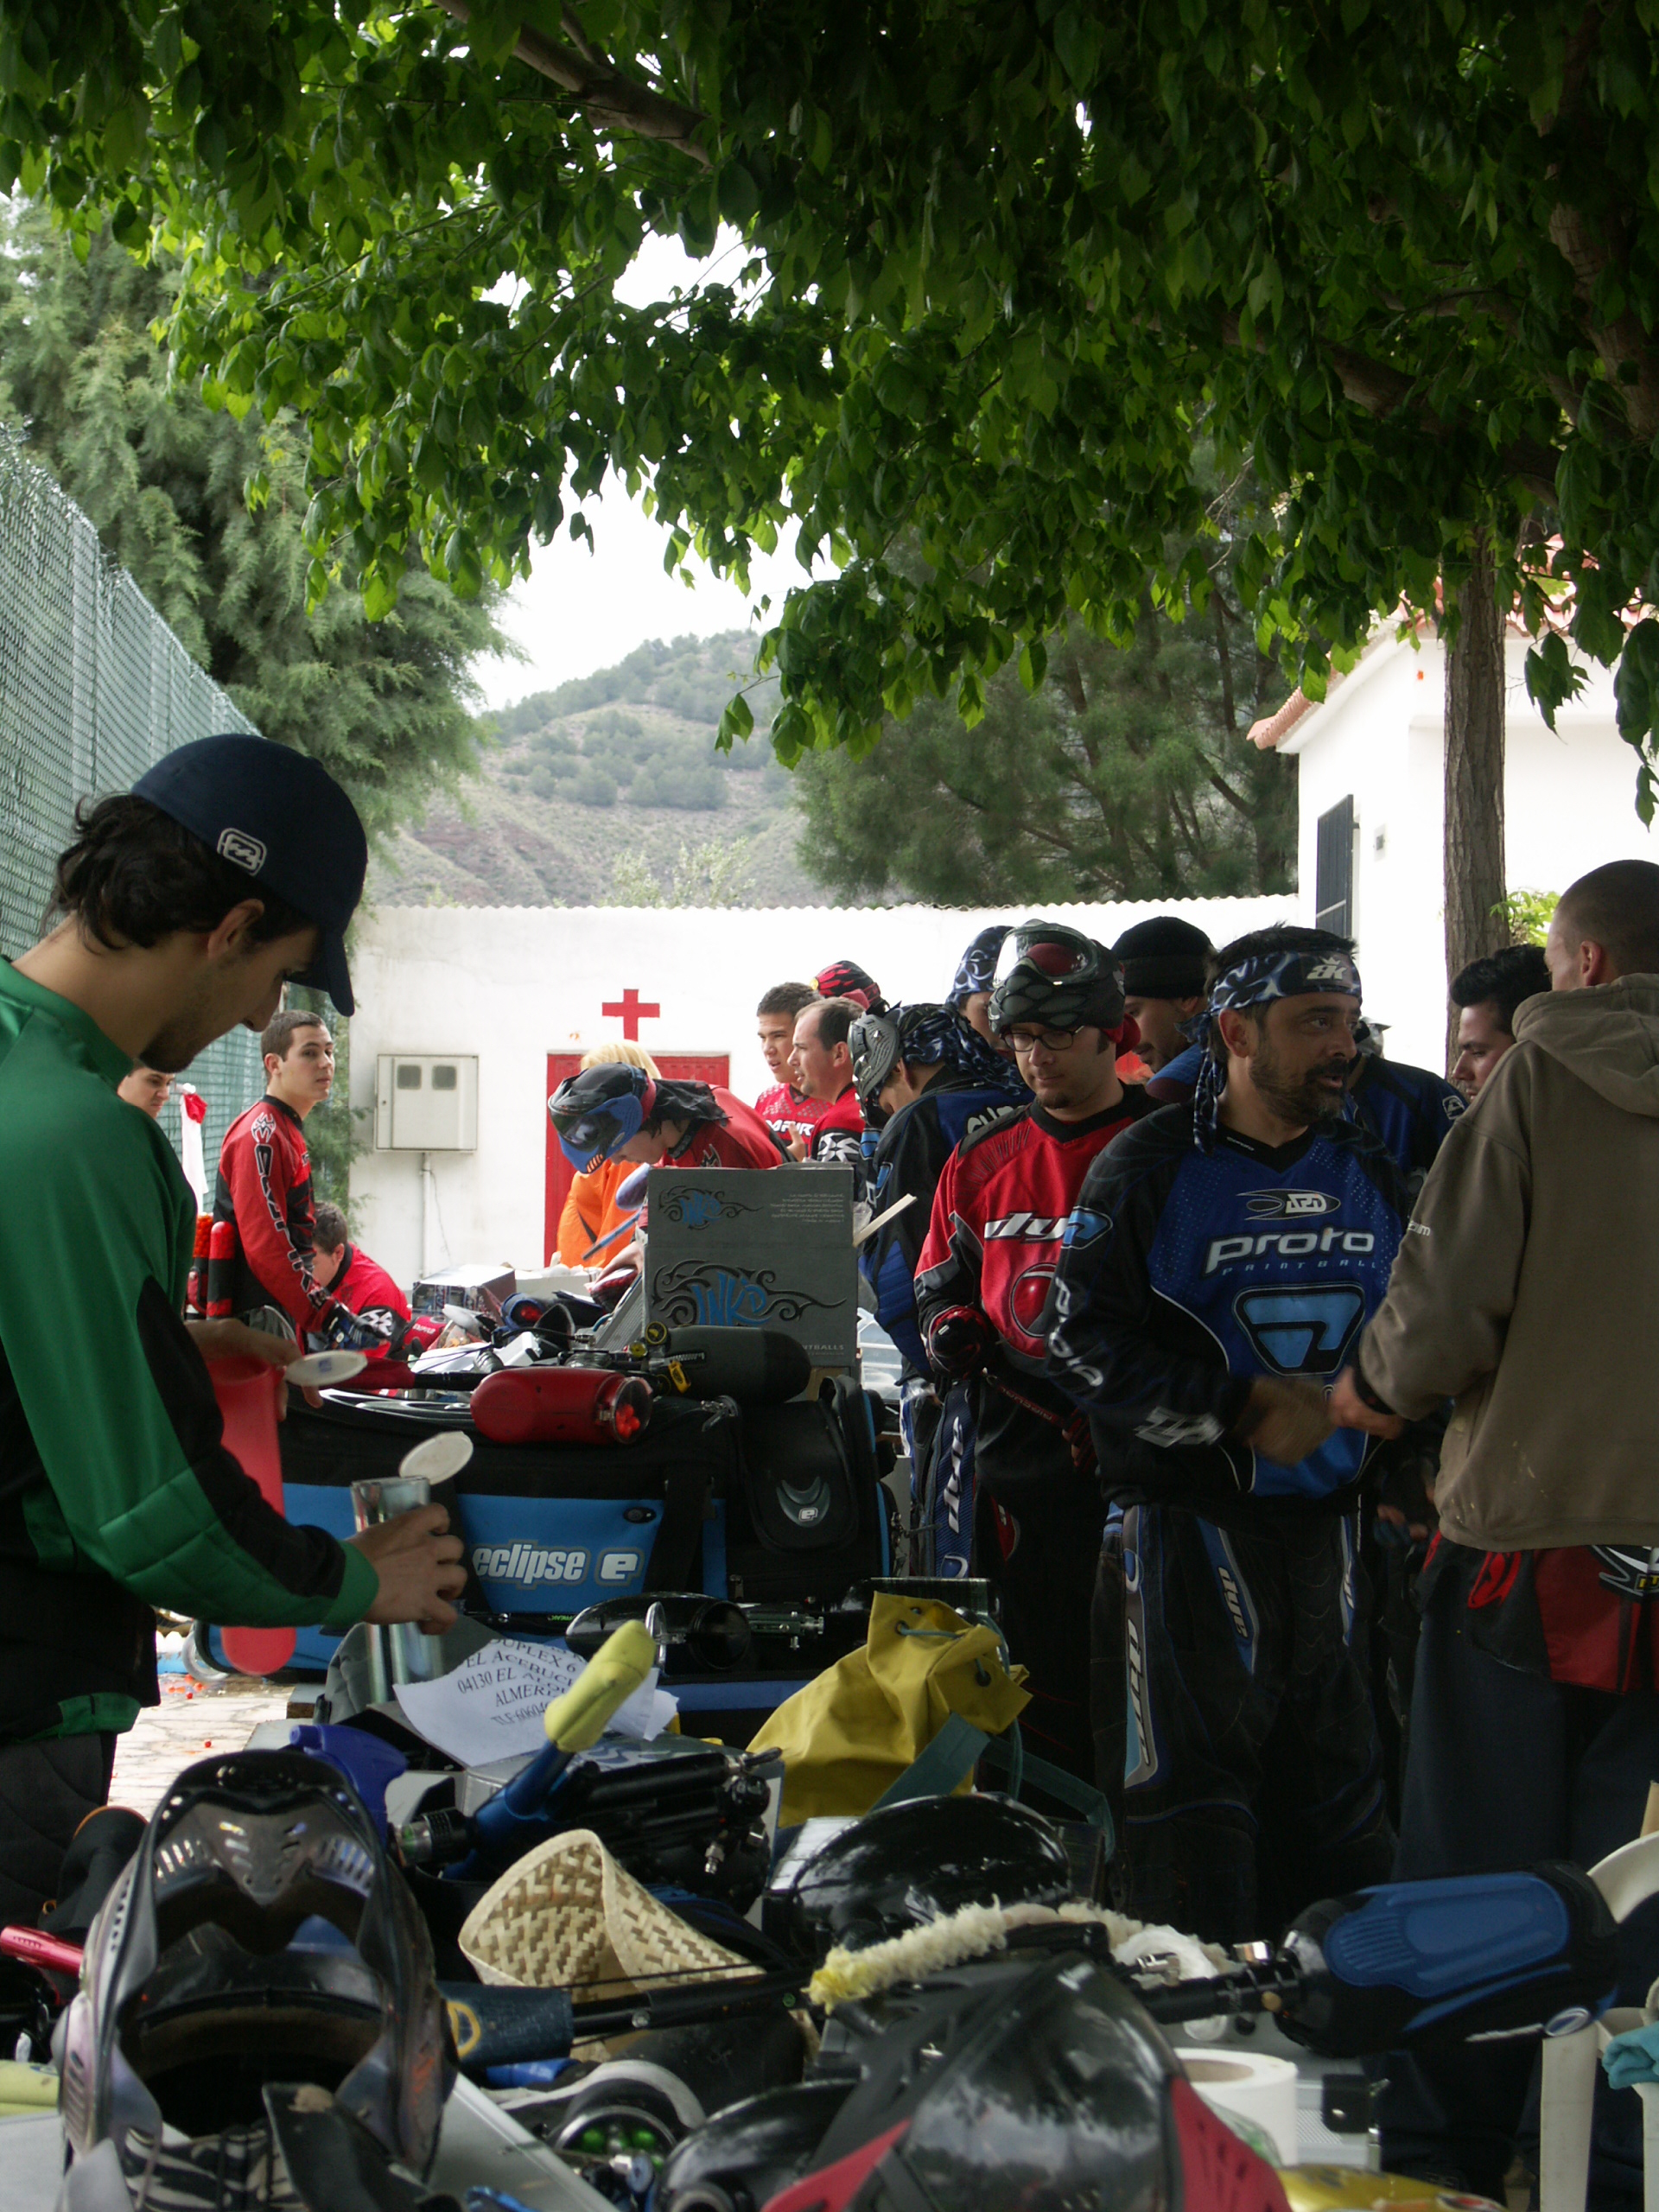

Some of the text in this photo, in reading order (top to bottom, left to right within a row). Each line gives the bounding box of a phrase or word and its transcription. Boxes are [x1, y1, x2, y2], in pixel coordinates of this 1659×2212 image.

[765, 1119, 814, 1136] MPIR
[984, 1212, 1069, 1242] dy
[1207, 1227, 1375, 1274] proto
[472, 1543, 587, 1584] eclipse
[1217, 1566, 1249, 1638] dye
[467, 1651, 486, 1669] EL
[566, 1662, 577, 1673] 6
[457, 1670, 493, 1695] 04130
[497, 1668, 518, 1683] EL
